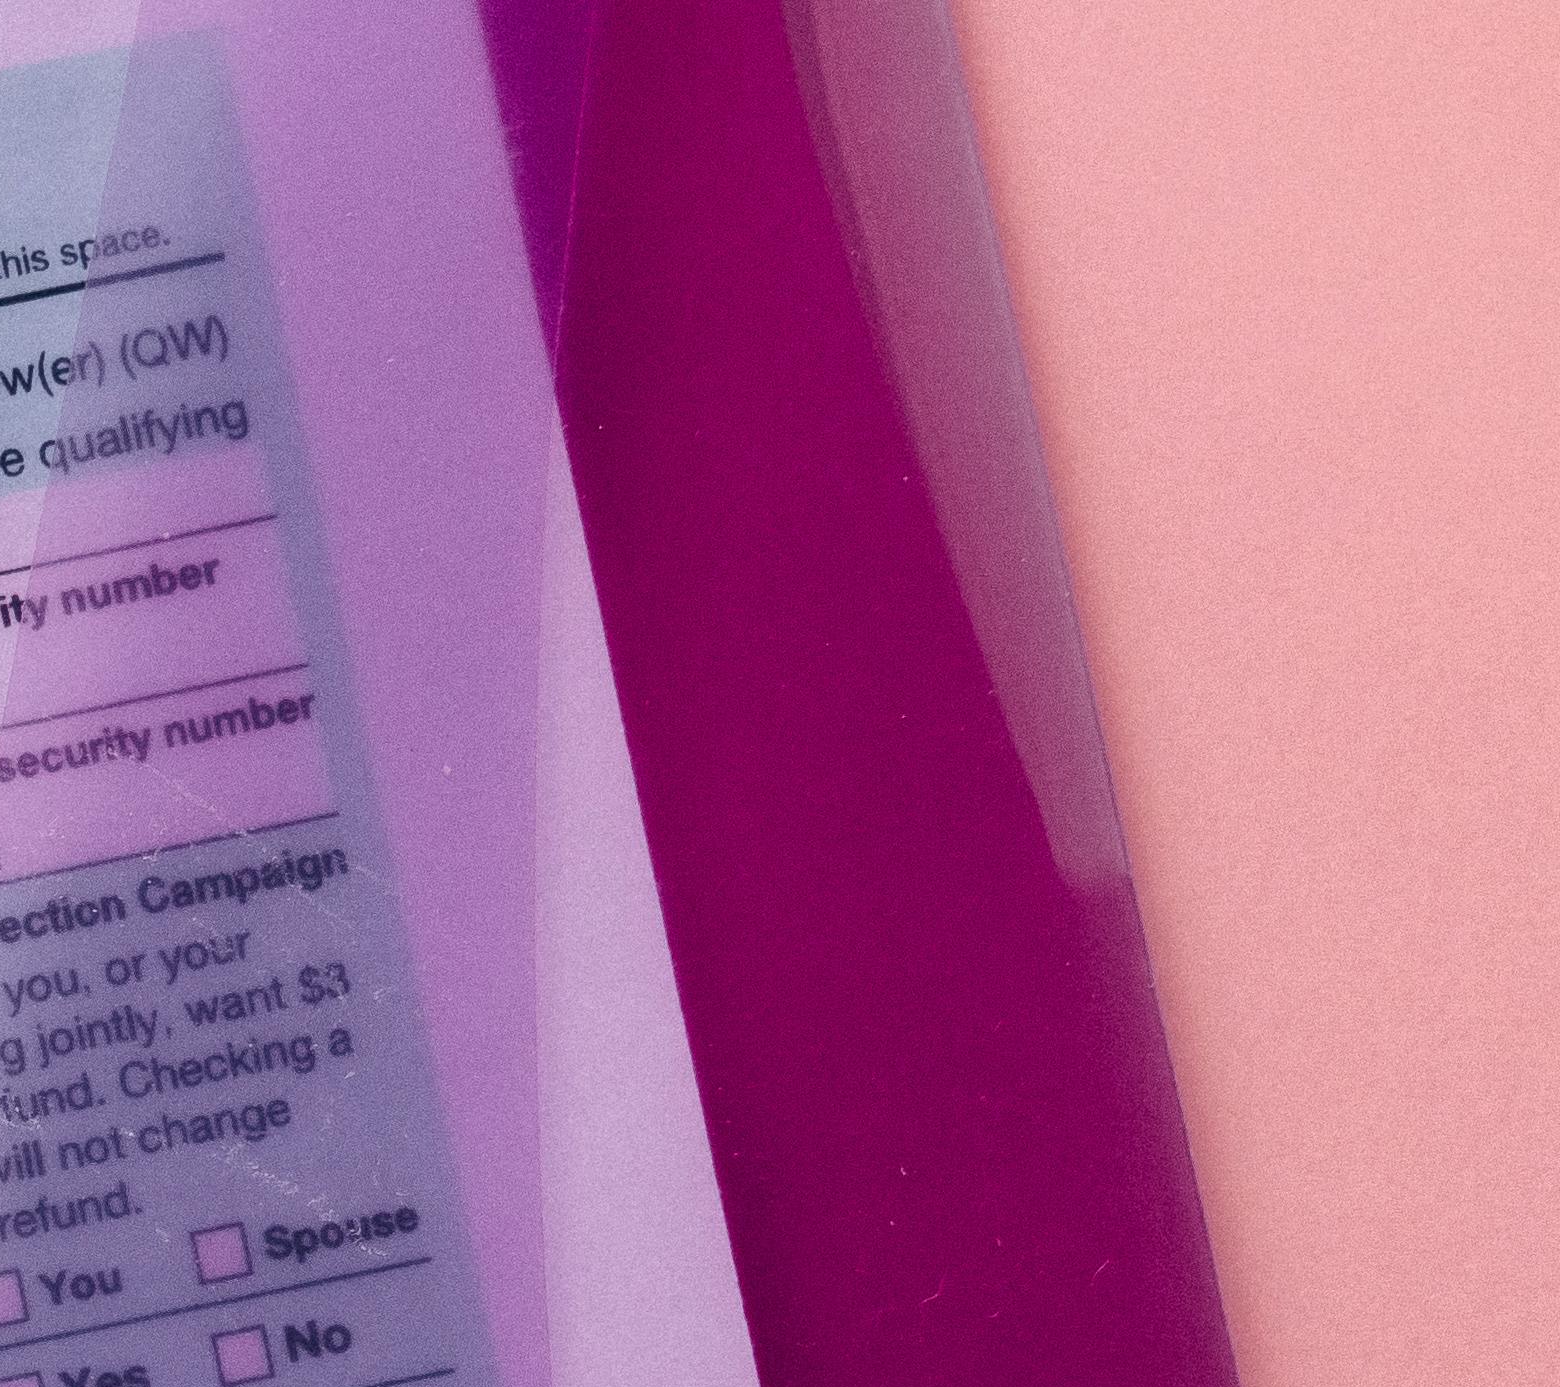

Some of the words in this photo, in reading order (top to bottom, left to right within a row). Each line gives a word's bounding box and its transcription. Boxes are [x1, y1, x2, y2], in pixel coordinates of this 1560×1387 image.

[59, 225, 171, 269] space.
[119, 314, 230, 379] (QW)
[60, 558, 220, 616] number
[163, 693, 316, 748] number
[136, 848, 349, 915] Campaign
[262, 1206, 421, 1264] Spouse
[37, 1267, 124, 1306] You
[283, 1320, 353, 1363] No
